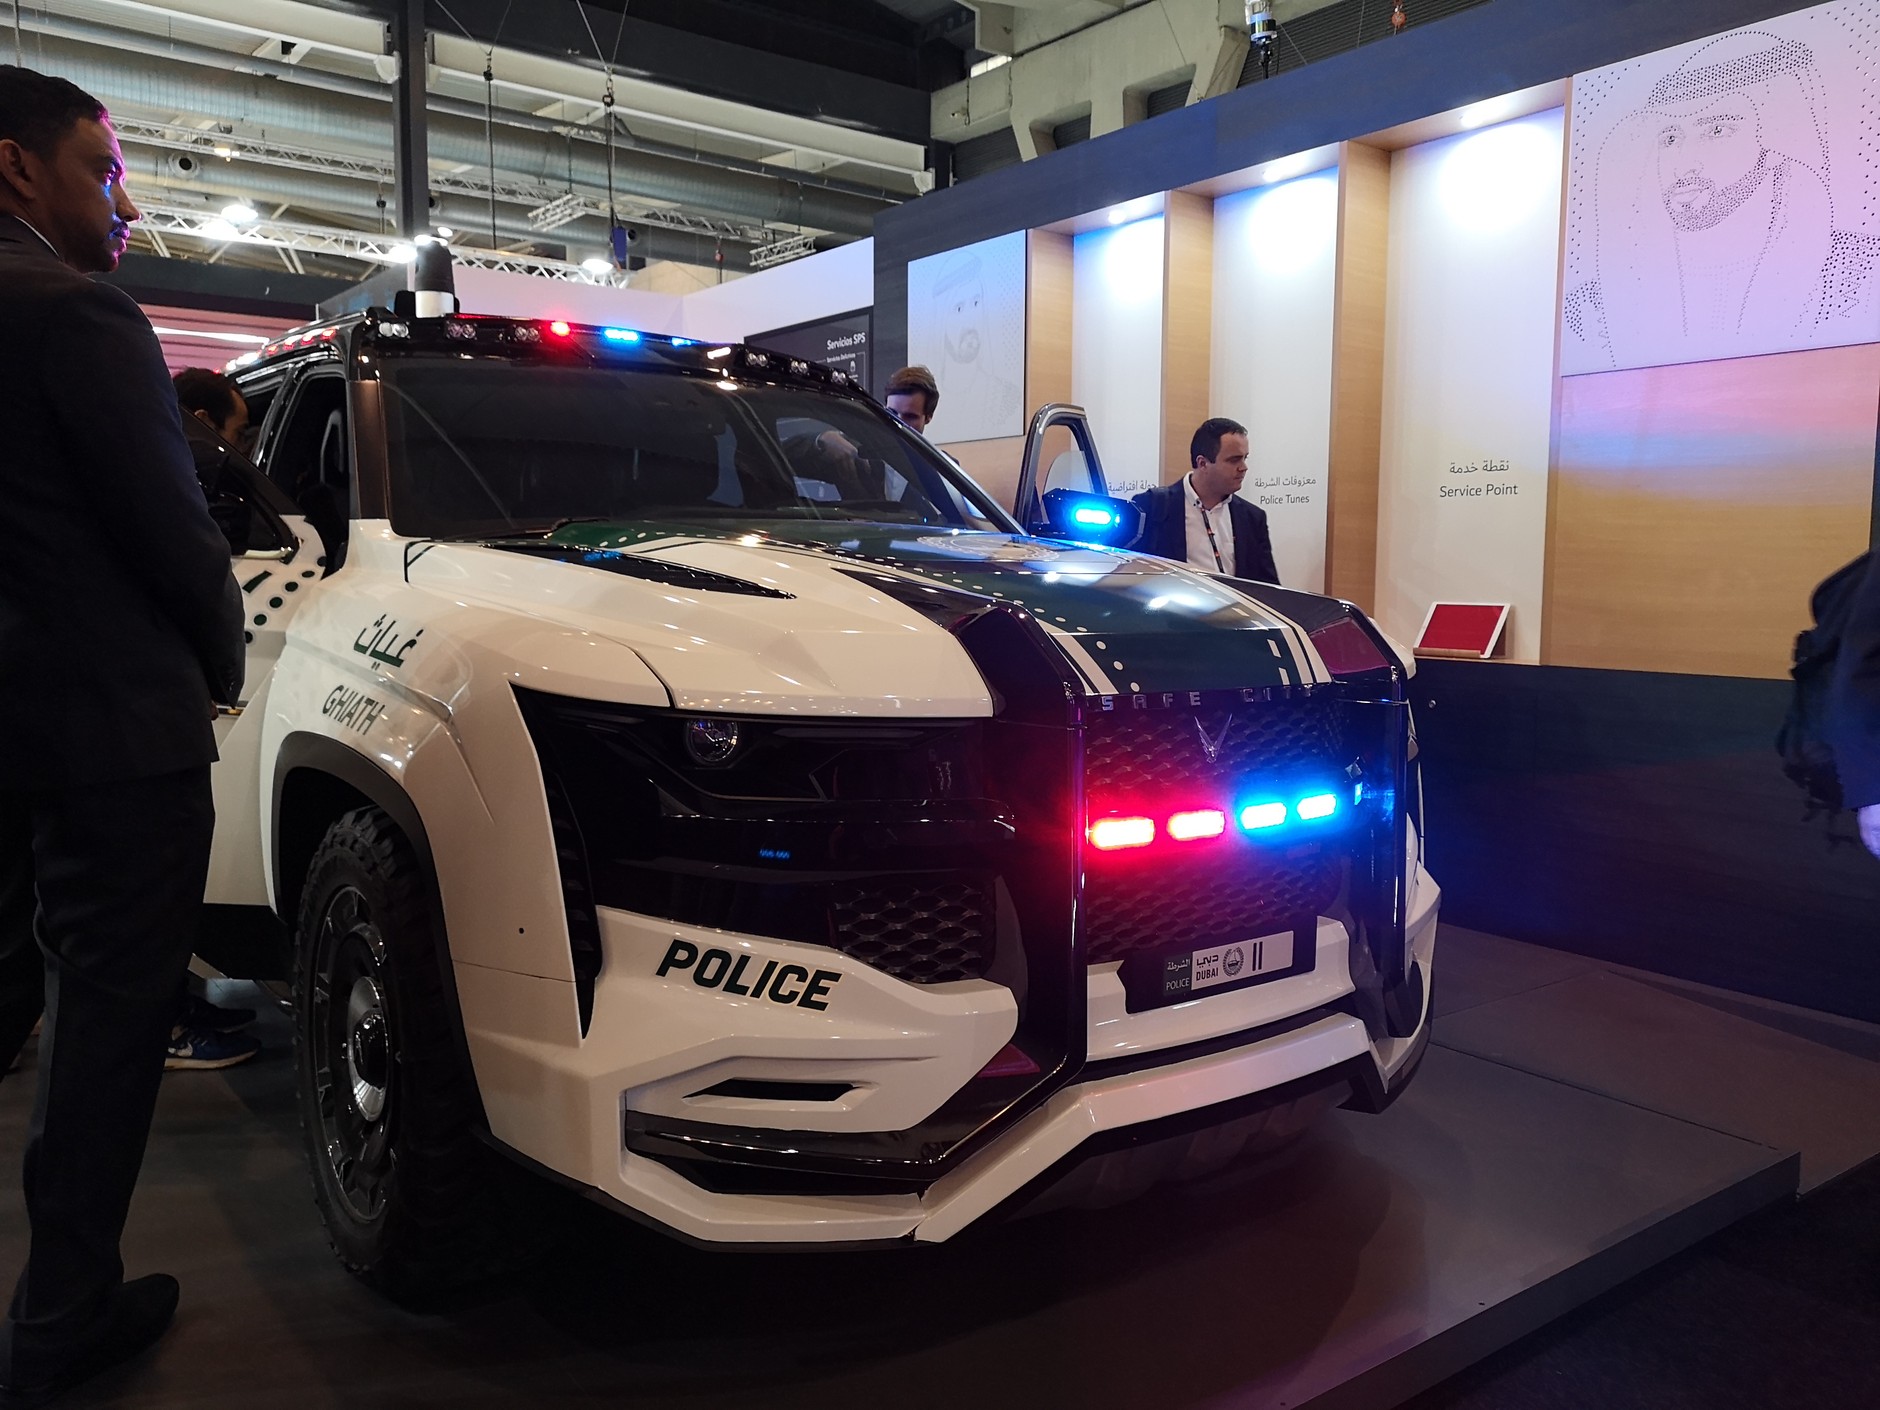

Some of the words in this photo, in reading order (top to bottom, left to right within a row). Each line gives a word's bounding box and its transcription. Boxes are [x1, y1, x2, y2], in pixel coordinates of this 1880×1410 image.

[827, 336, 853, 350] Servicios
[853, 332, 866, 344] SPS
[1449, 462, 1478, 474] خدمة
[1482, 459, 1510, 472] نقطة
[1254, 477, 1281, 489] الشرطة
[1282, 475, 1317, 488] معزوفات
[1439, 485, 1482, 498] Service
[1486, 483, 1518, 496] Point
[1260, 495, 1283, 505] Police
[1285, 493, 1310, 504] Tunes
[353, 613, 424, 671] غياث
[322, 684, 386, 736] GHIATH
[1101, 691, 1201, 711] SAFE
[1167, 958, 1191, 972] الشرطة
[1196, 954, 1219, 968] دبي
[655, 938, 843, 1011] POLICE
[1165, 977, 1190, 991] POLICE
[1196, 967, 1219, 982] DUBAI
